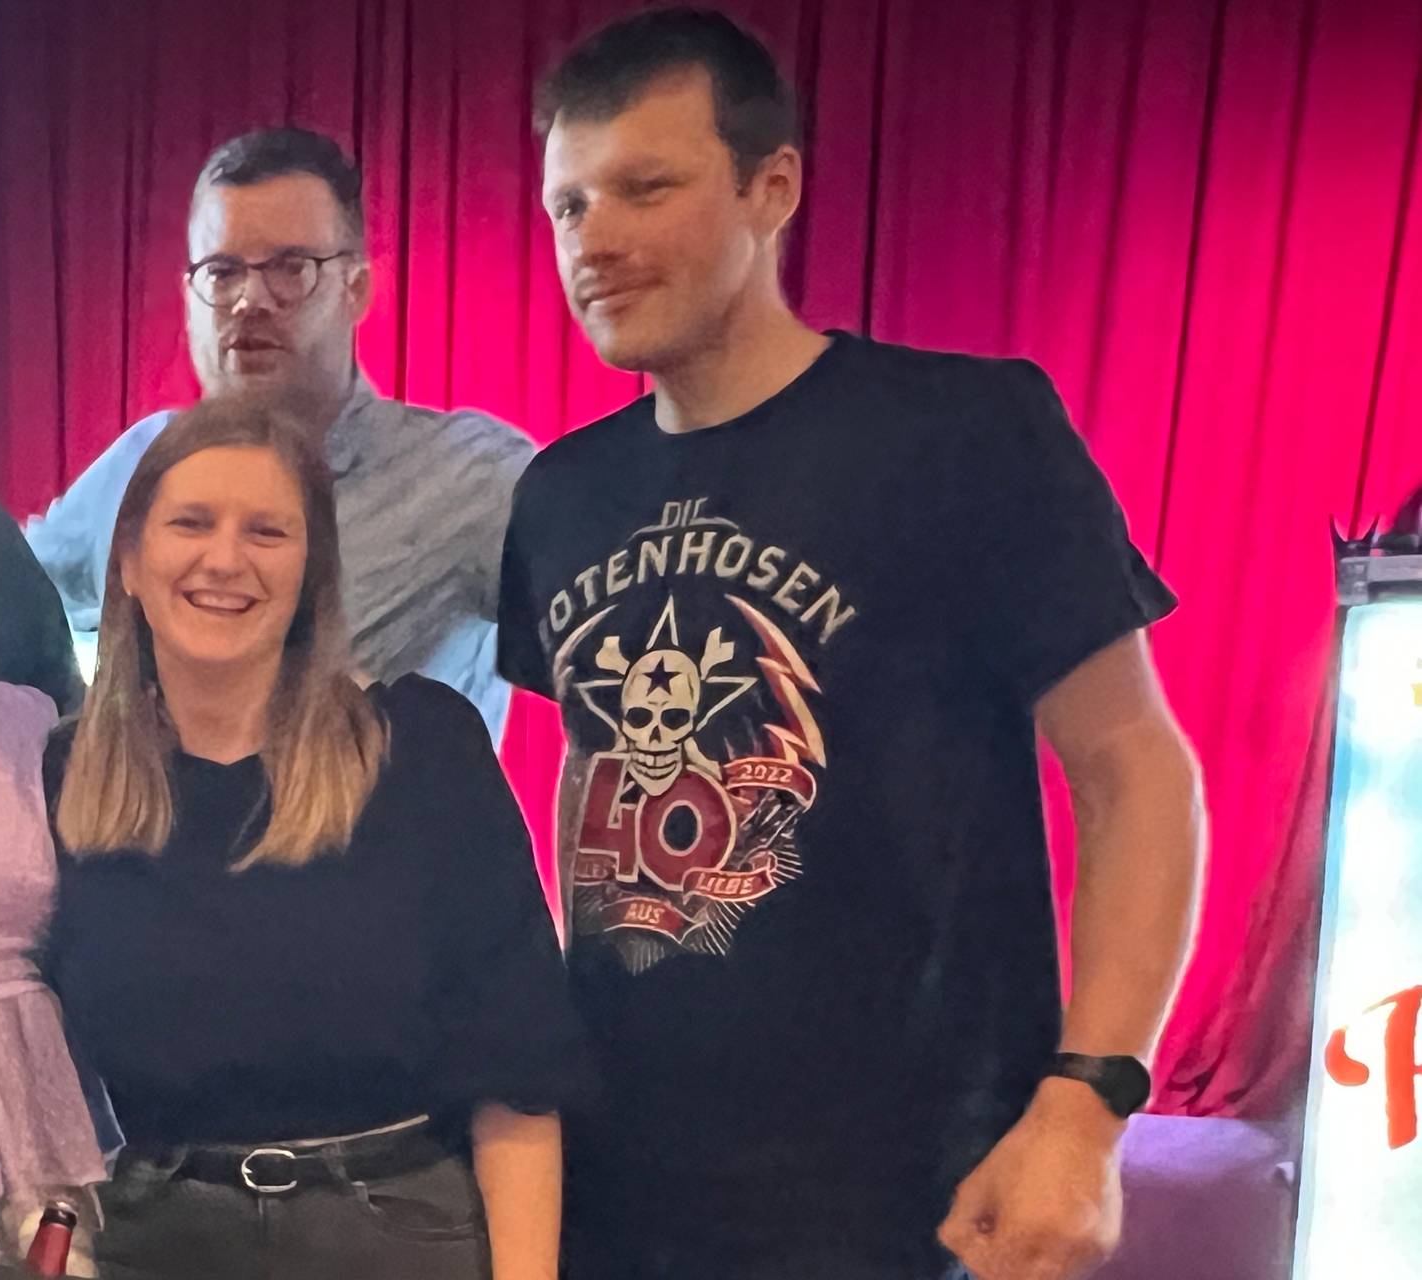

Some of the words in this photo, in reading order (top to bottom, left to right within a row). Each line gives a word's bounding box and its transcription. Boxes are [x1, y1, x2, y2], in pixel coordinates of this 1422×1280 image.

[738, 764, 793, 783] 2022
[578, 752, 737, 890] 40
[625, 903, 666, 924] AUS
